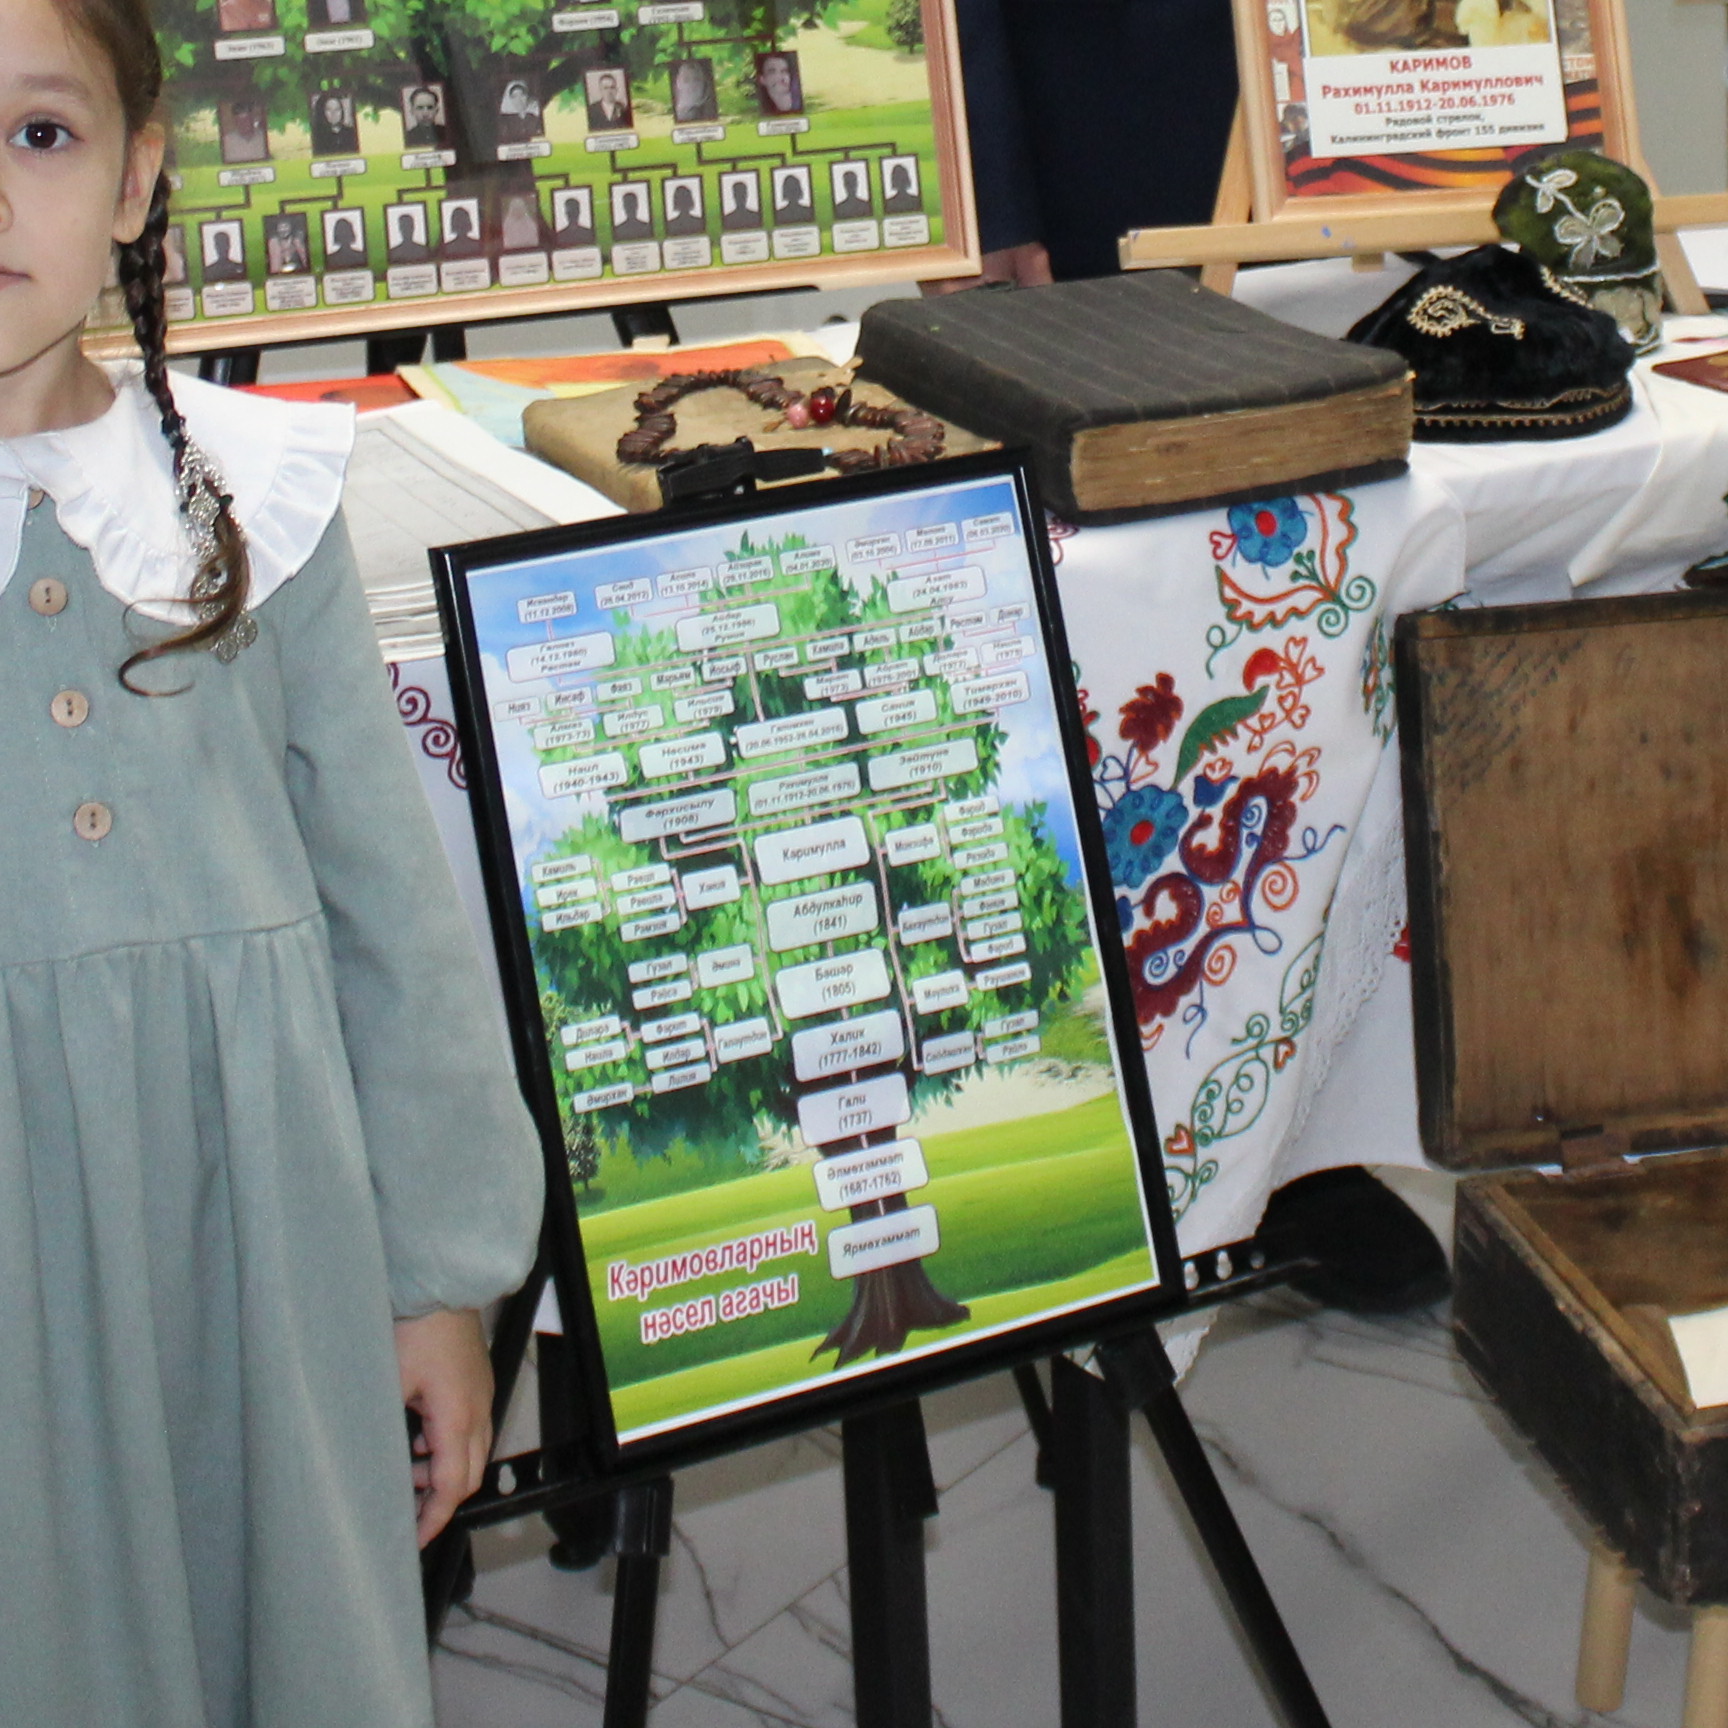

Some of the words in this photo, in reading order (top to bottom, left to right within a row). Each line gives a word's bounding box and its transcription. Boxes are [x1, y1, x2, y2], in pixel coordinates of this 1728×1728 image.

[1390, 55, 1472, 74] КАРИМОВ
[1322, 82, 1414, 100] Рахимулла
[1420, 74, 1544, 95] Каримуллович
[1354, 93, 1516, 115] 01.11.1912-20.06.1976
[884, 711, 917, 727] (1945)
[553, 771, 620, 794] (1940-1943)
[813, 915, 848, 936] (1841)
[819, 1041, 882, 1071] (1777-1842)
[839, 1110, 873, 1133] (1737)
[610, 1222, 816, 1299] Кәримовларның
[642, 1298, 713, 1341] нәсел
[721, 1275, 797, 1318] агачы
